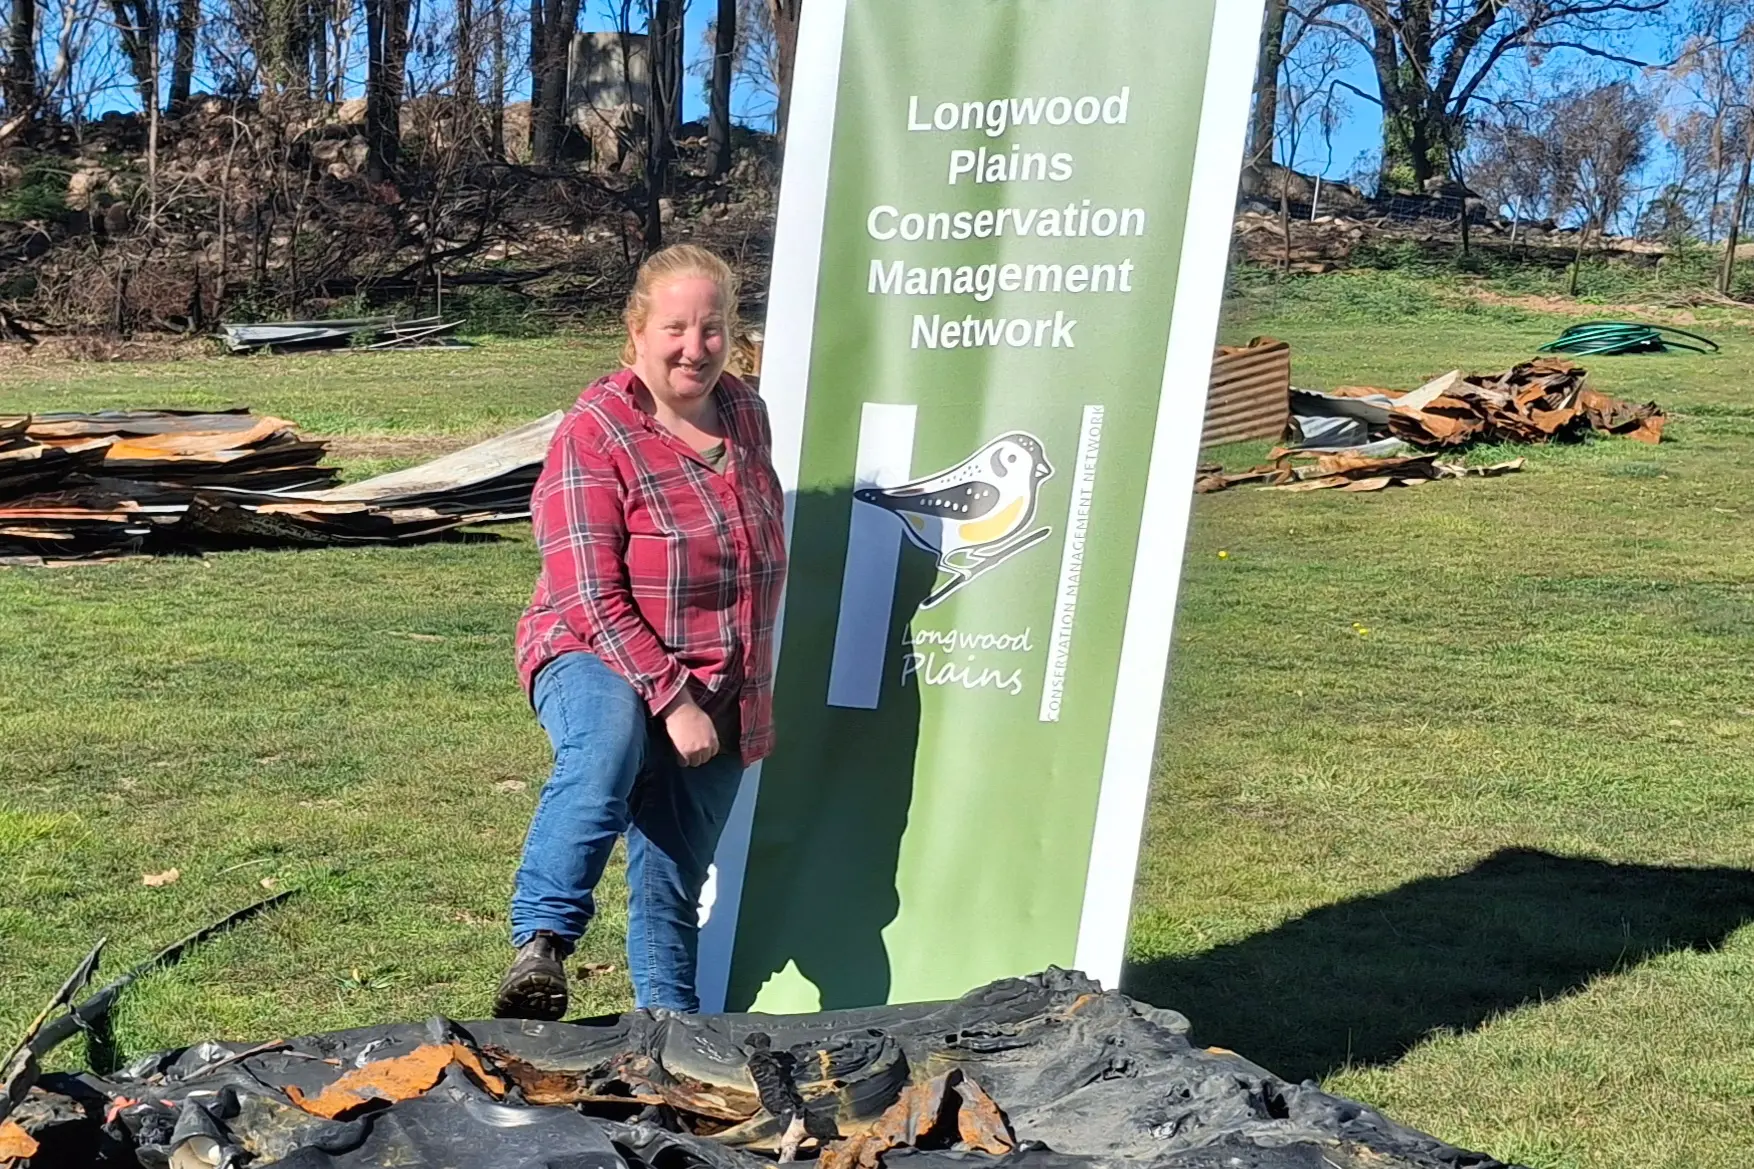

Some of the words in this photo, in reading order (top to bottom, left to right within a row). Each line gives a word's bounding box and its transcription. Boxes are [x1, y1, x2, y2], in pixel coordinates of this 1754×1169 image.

[907, 86, 1130, 137] Longwood
[948, 143, 1074, 184] Plains
[866, 199, 1146, 241] Conservation
[866, 257, 1134, 302] Management
[910, 311, 1077, 349] Network
[1047, 603, 1076, 722] CONSERVATION
[1066, 488, 1092, 596] MANAGEMENT
[1083, 407, 1104, 482] NETWORK
[902, 623, 1033, 654] Longwood
[901, 652, 1023, 695] Plains
